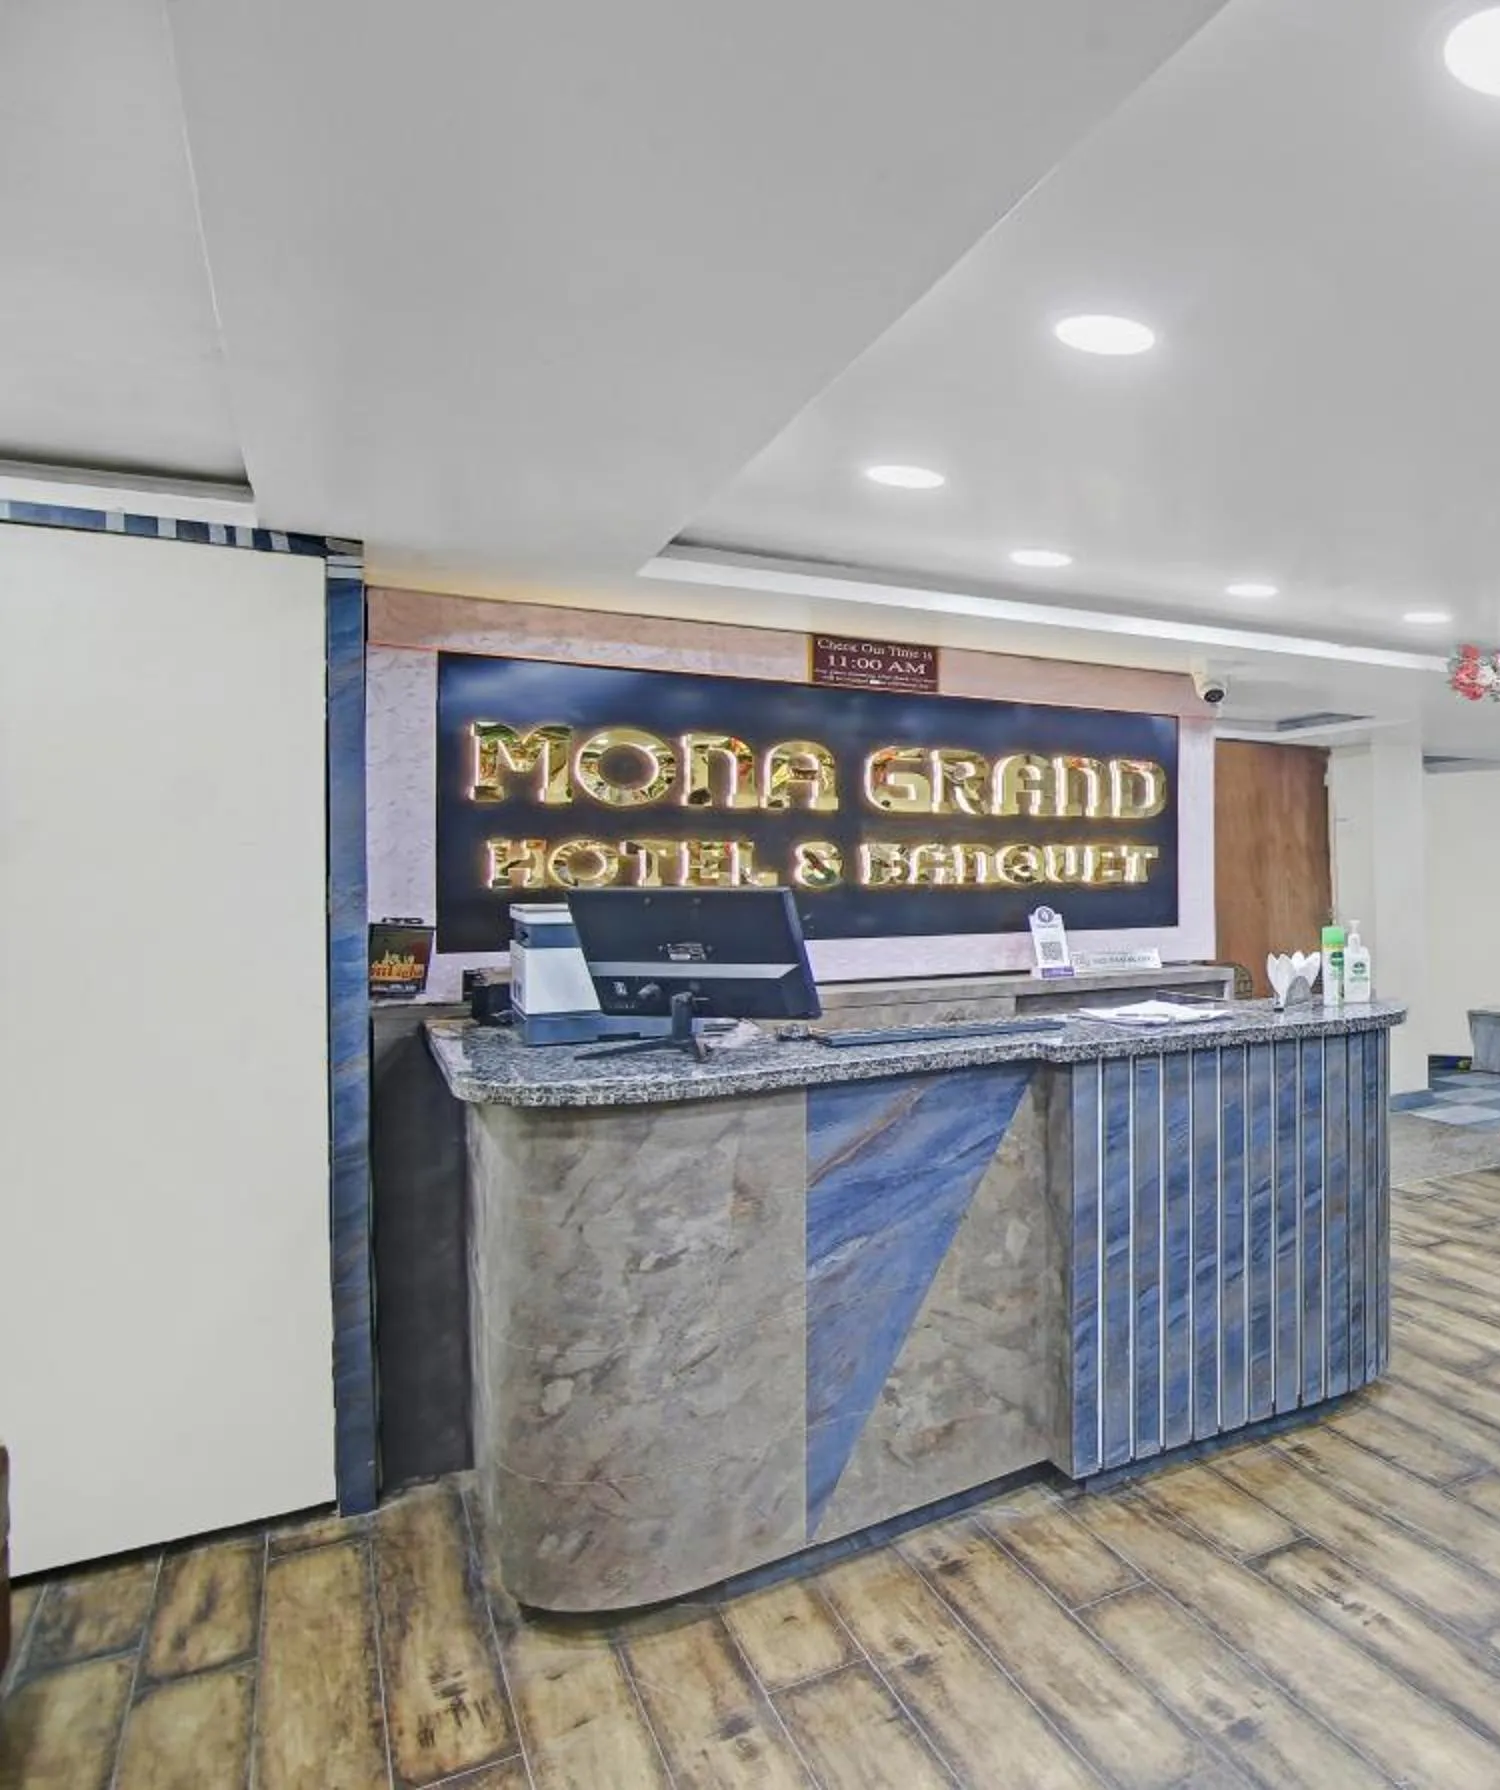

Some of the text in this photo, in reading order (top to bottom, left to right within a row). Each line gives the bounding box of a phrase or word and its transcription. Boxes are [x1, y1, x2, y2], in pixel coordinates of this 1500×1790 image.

[828, 655, 926, 675] 11:00 AM
[887, 646, 919, 659] Time
[468, 720, 1168, 819] MONA GRAND
[486, 838, 1160, 890] HOTEL & BANQUET
